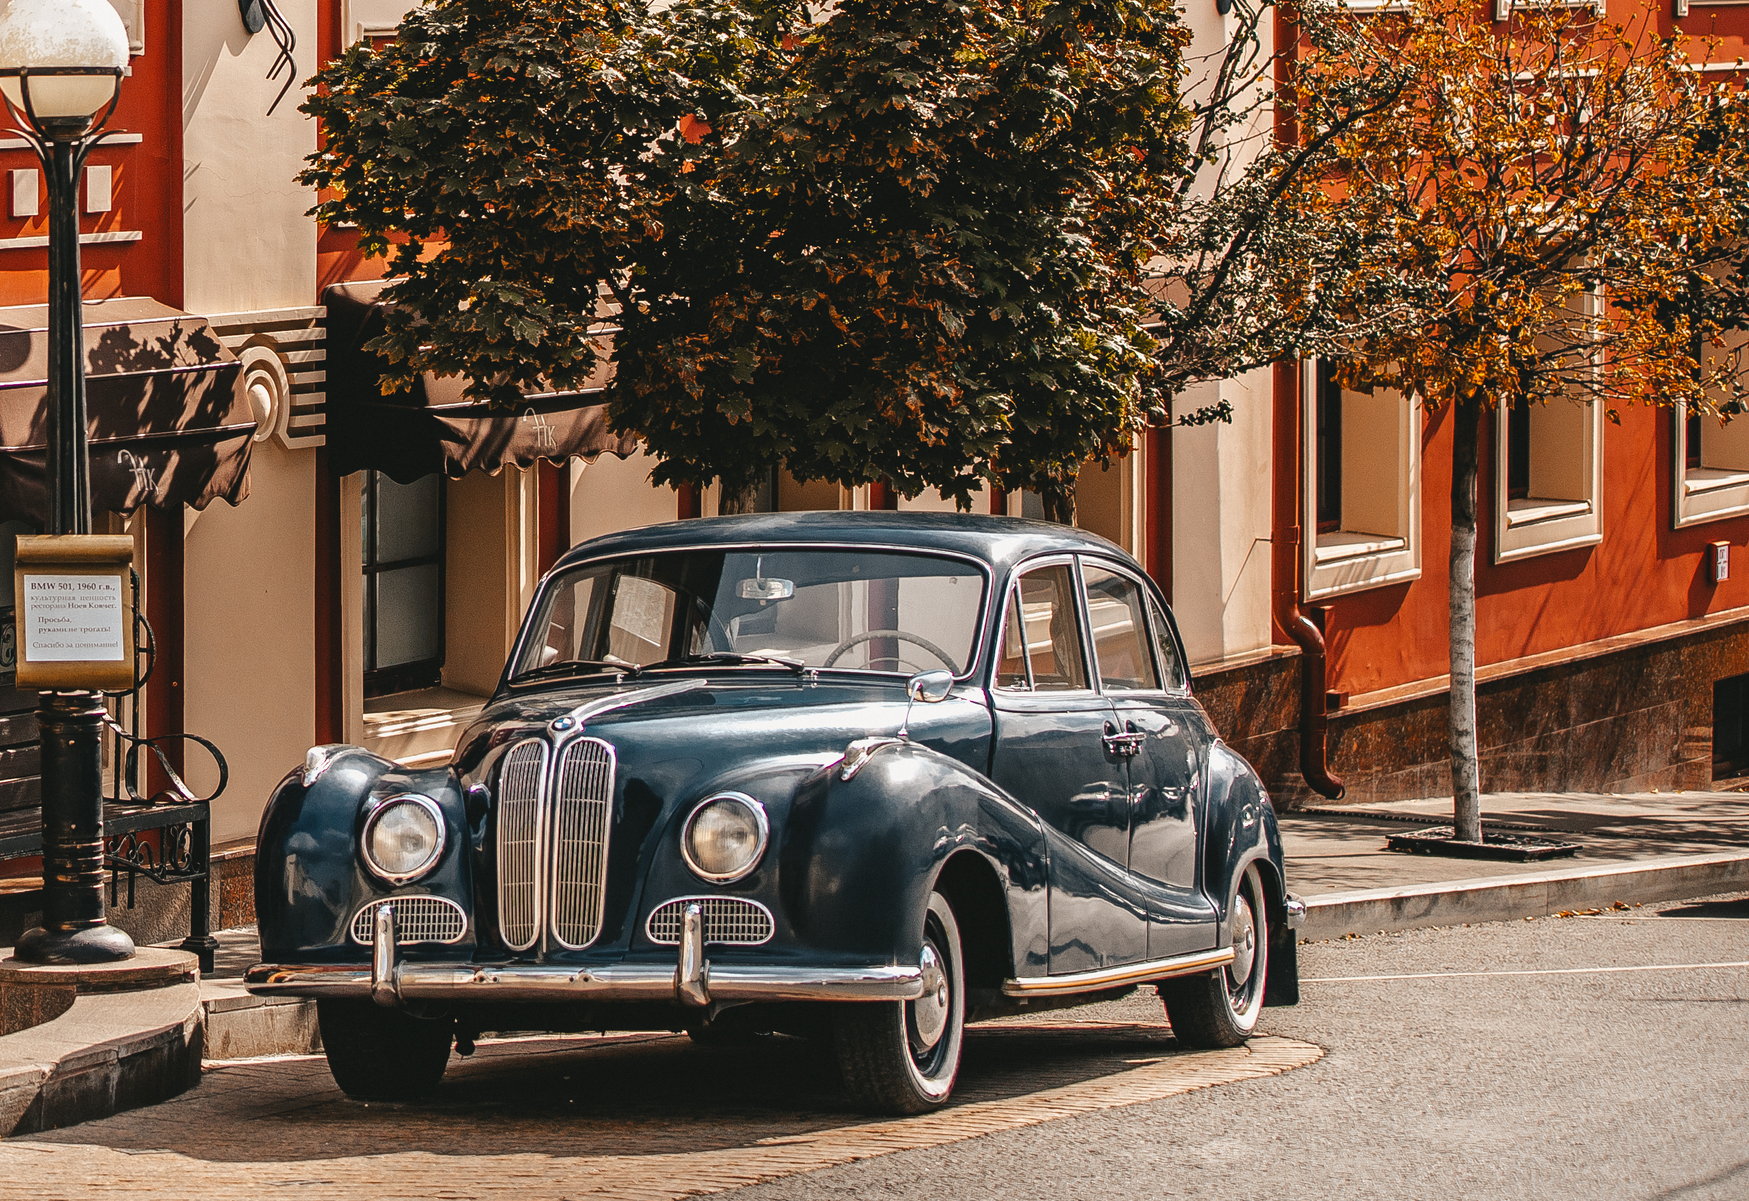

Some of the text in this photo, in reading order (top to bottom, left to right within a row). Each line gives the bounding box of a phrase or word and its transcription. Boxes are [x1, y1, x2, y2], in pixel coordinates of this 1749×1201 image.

[30, 582, 56, 590] BMW
[58, 582, 75, 591] 501,
[77, 582, 96, 590] 1960
[38, 616, 72, 624] Просьба,
[80, 626, 111, 634] трогать!
